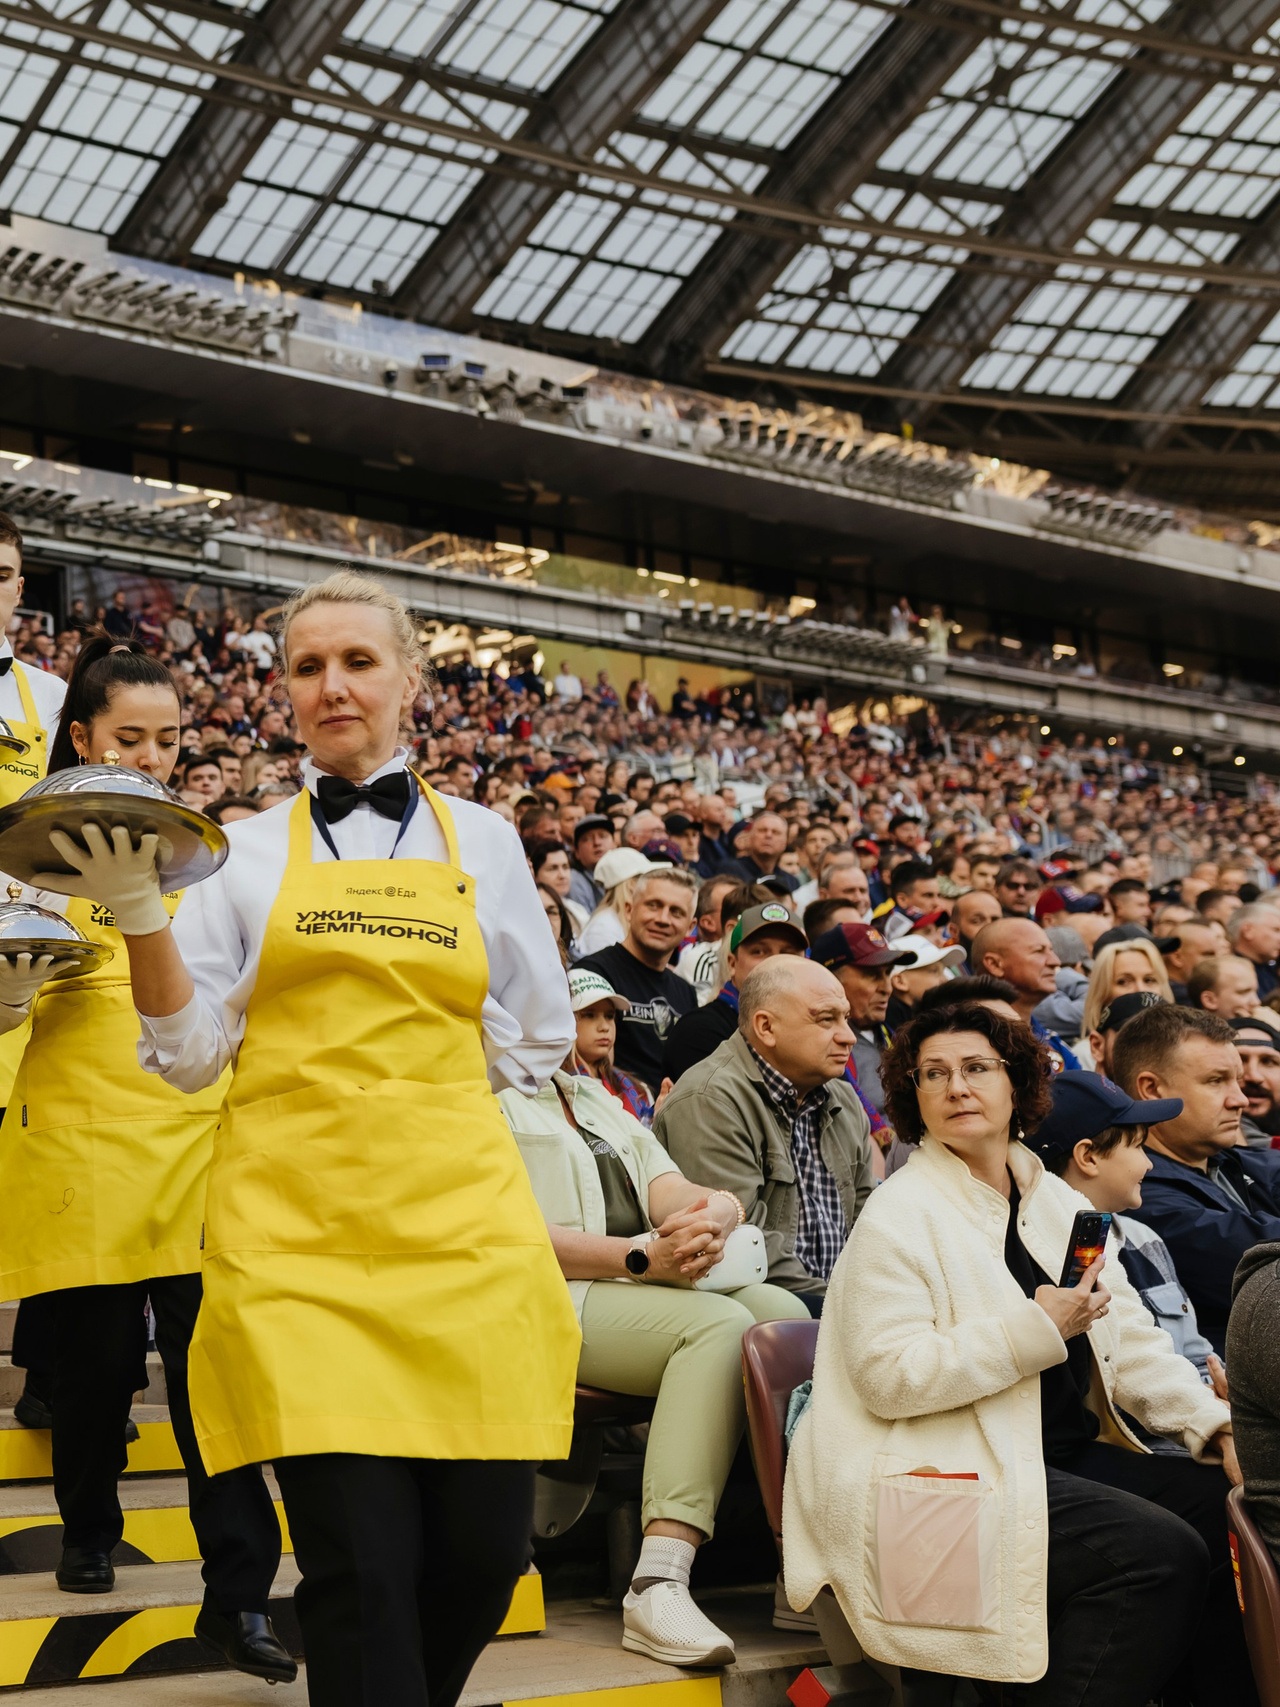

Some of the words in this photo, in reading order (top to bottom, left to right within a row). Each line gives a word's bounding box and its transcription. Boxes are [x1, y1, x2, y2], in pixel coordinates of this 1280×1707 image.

[345, 887, 383, 896] Яндекс
[397, 887, 417, 898] Еда
[295, 921, 458, 950] ЧЕМПИОНОВ
[296, 909, 458, 938] УЖИН
